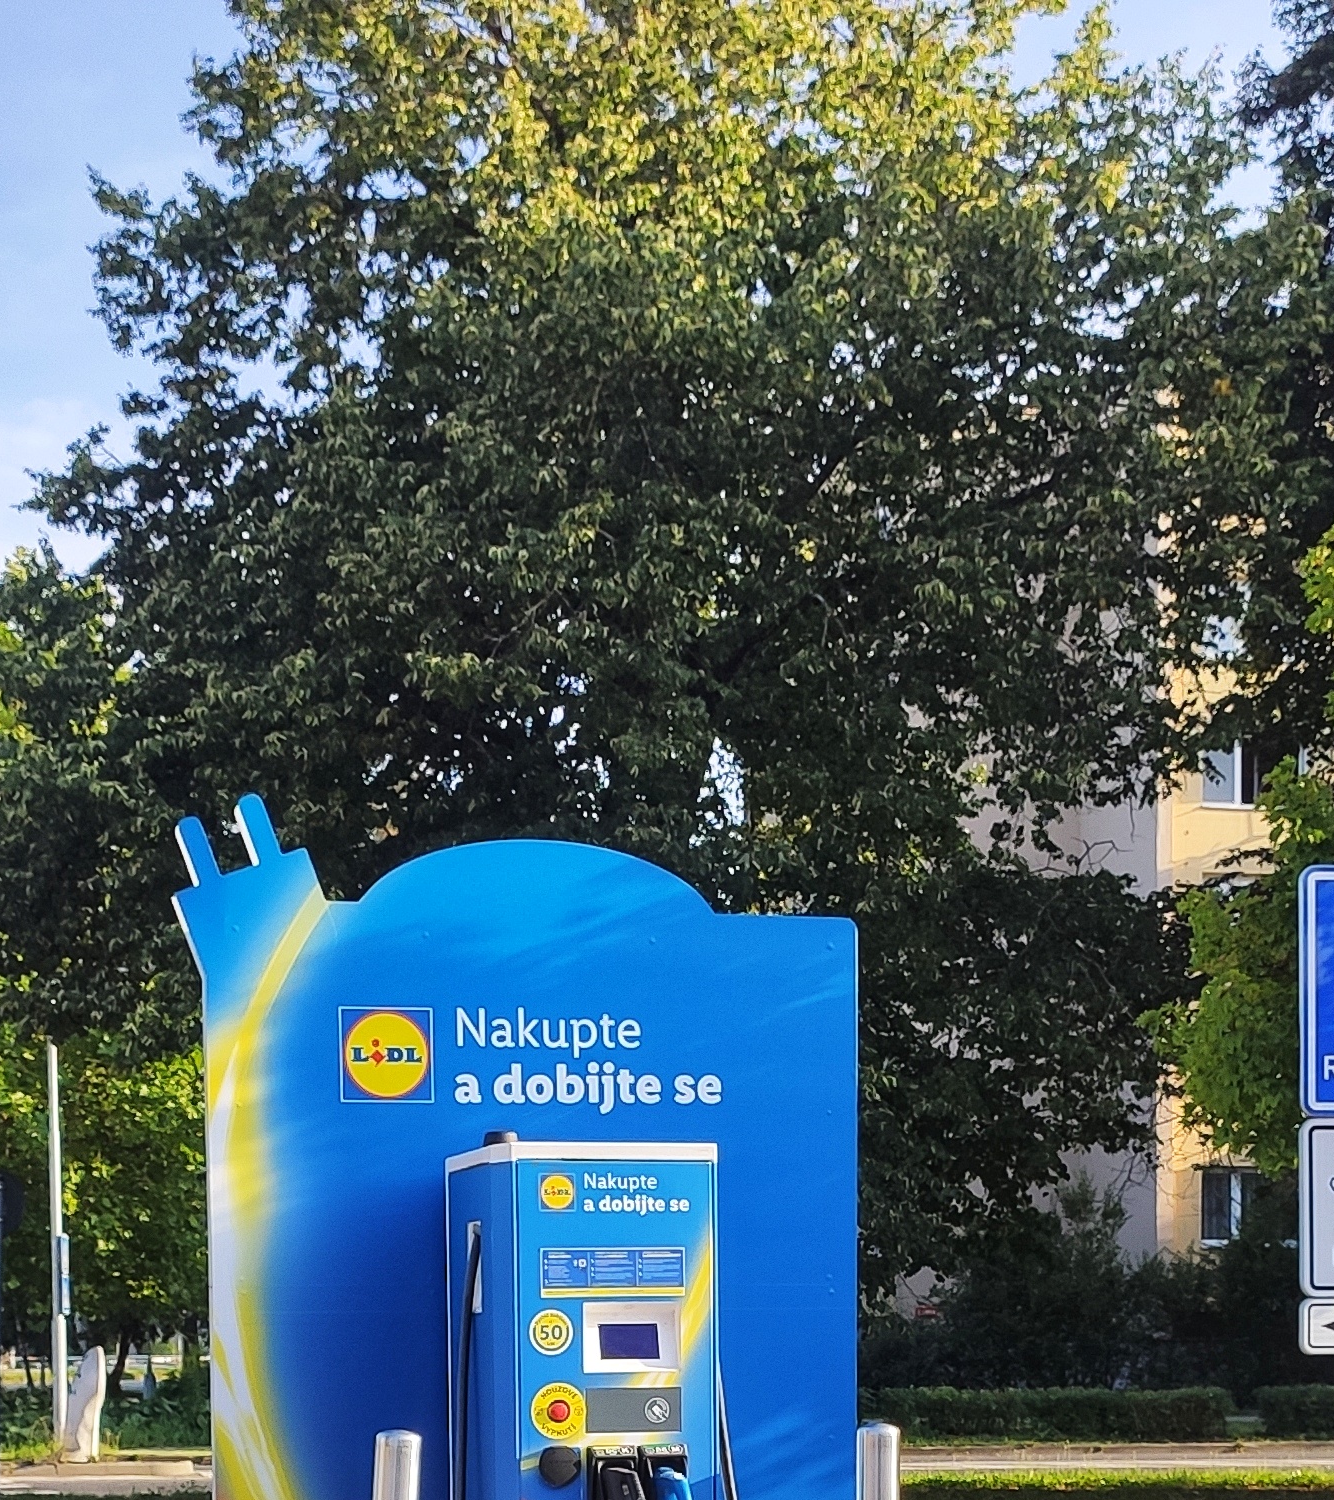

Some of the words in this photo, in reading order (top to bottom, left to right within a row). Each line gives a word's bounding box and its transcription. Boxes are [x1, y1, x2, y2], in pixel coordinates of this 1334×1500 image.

[455, 1007, 642, 1058] Nakupte
[350, 1038, 423, 1067] LIDL
[454, 1073, 482, 1104] a
[493, 1062, 662, 1114] dobijte
[673, 1073, 723, 1104] se
[583, 1172, 658, 1193] Nakupte
[583, 1198, 596, 1212] a
[598, 1194, 666, 1216] dobijte
[669, 1198, 690, 1212] se
[540, 1324, 563, 1341] 50
